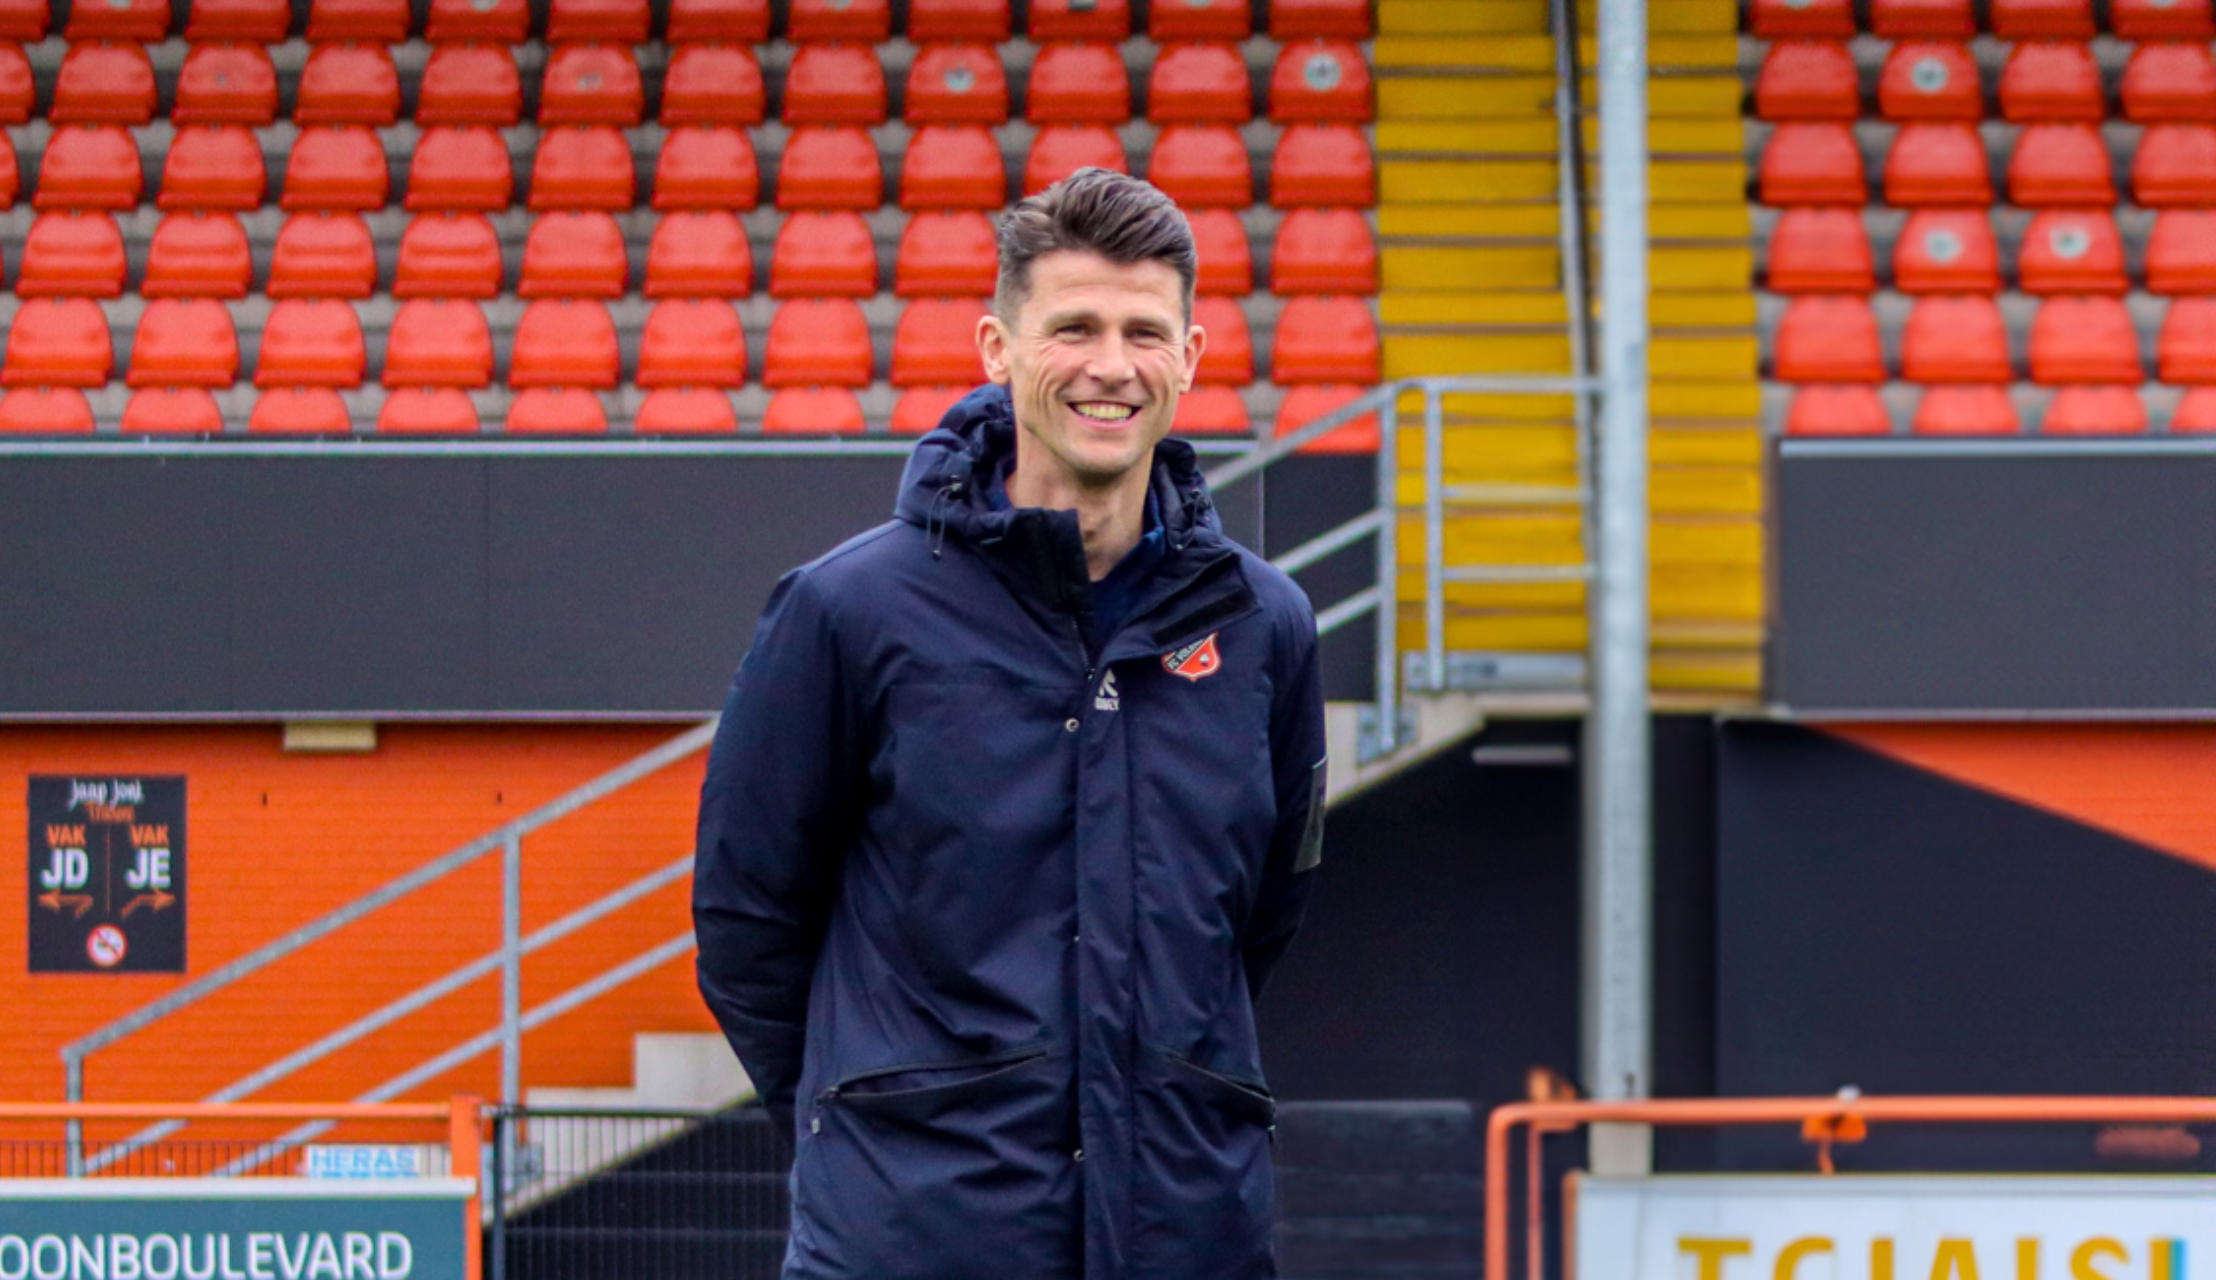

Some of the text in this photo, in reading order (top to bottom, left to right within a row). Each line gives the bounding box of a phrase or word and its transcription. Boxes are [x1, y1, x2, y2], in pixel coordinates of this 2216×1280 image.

[46, 824, 87, 847] VAK
[129, 824, 169, 847] VAK
[40, 848, 89, 889] JD
[125, 848, 171, 889] JE
[311, 1148, 416, 1172] HERAS
[0, 1232, 413, 1280] OONBOULEVARD
